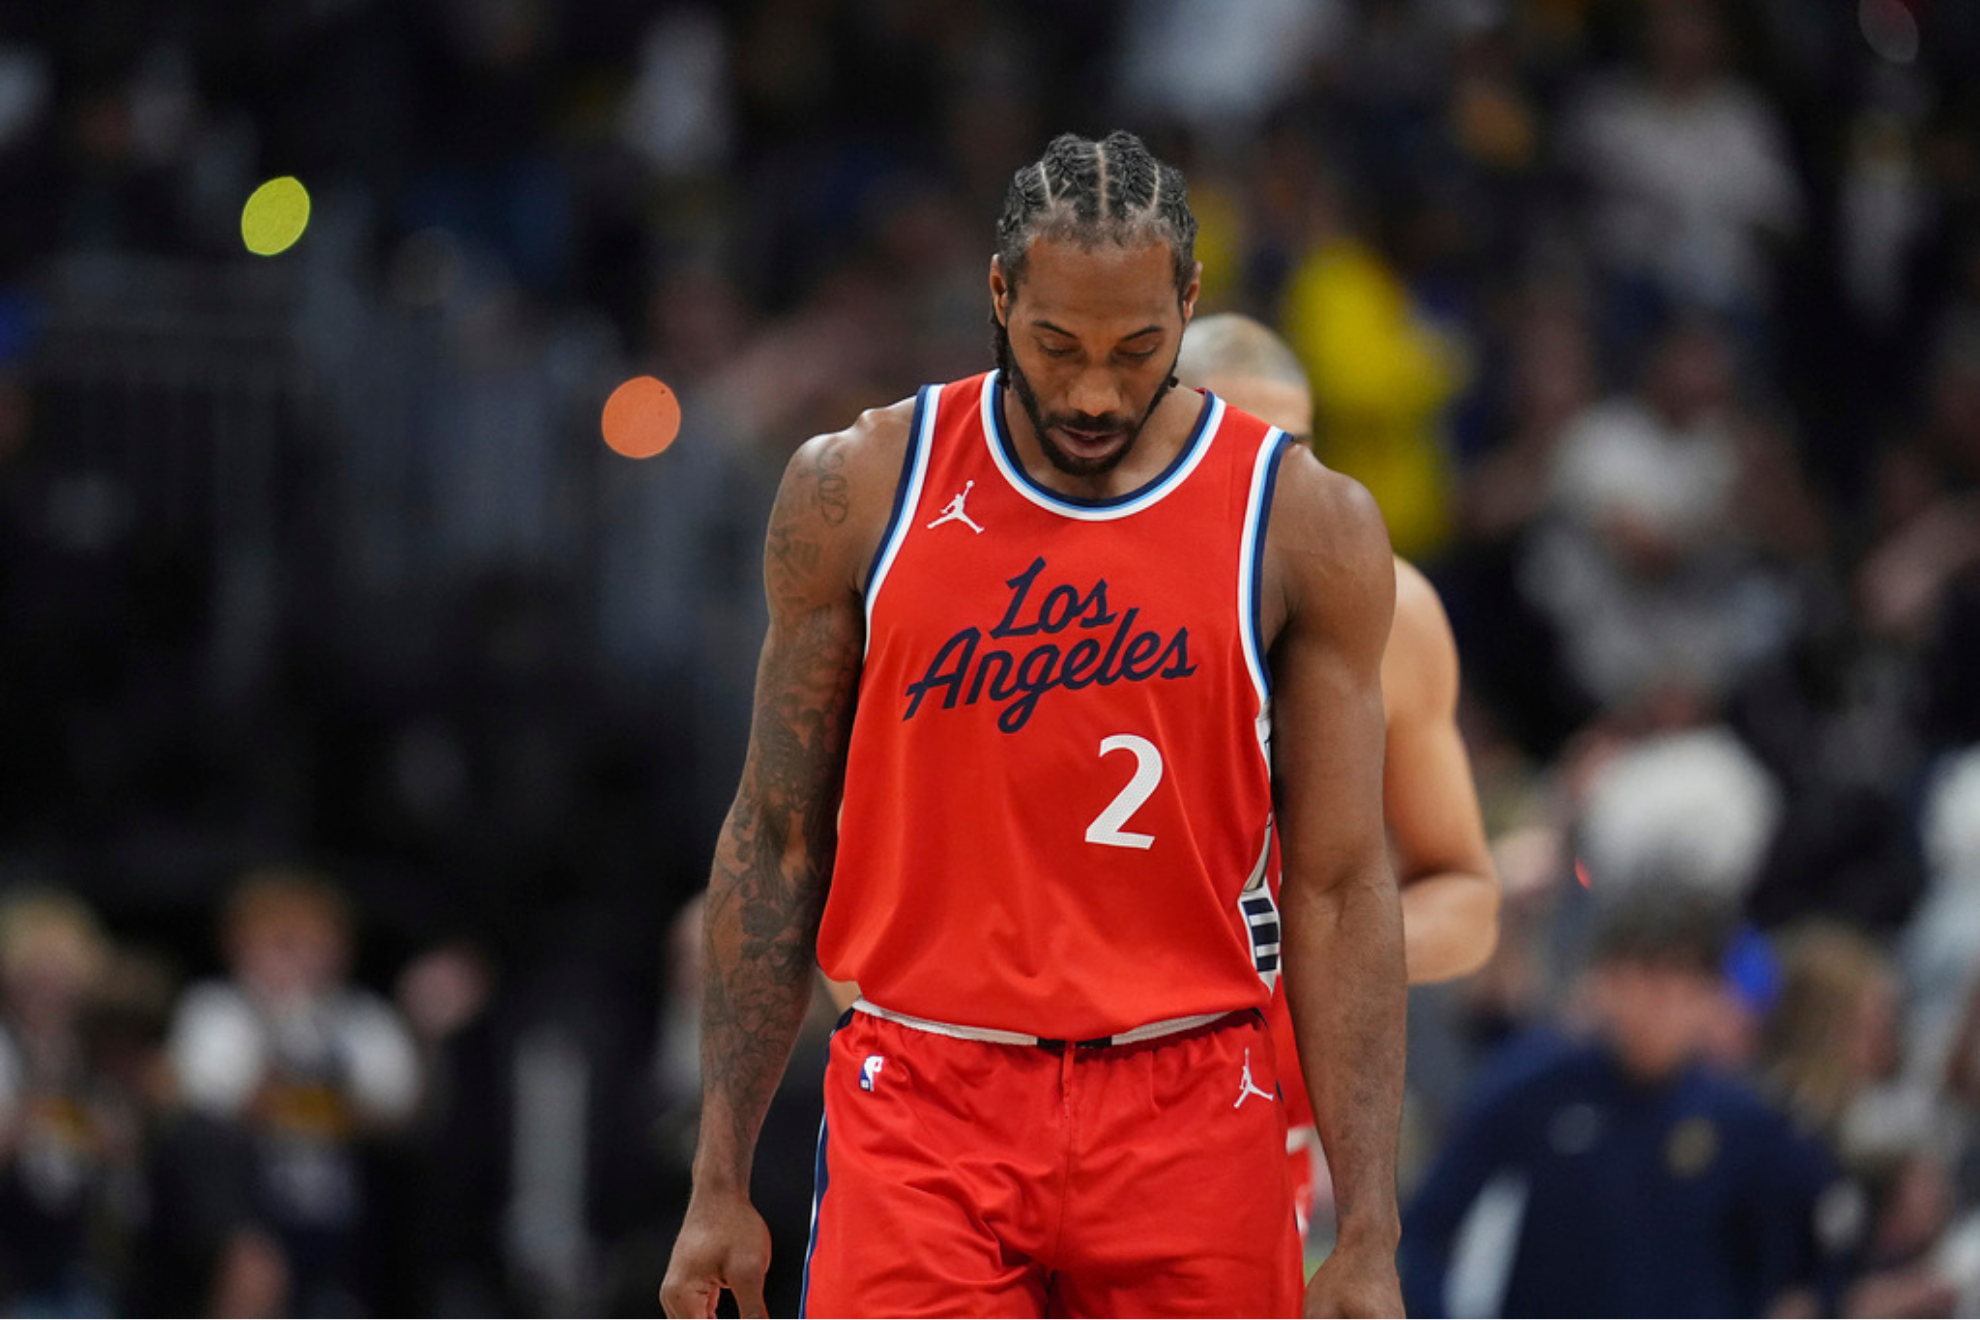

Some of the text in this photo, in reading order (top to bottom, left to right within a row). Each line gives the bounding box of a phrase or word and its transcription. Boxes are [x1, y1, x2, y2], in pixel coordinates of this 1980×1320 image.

[990, 556, 1118, 640] Los
[903, 607, 1198, 734] Angeles
[1084, 733, 1163, 850] 2
